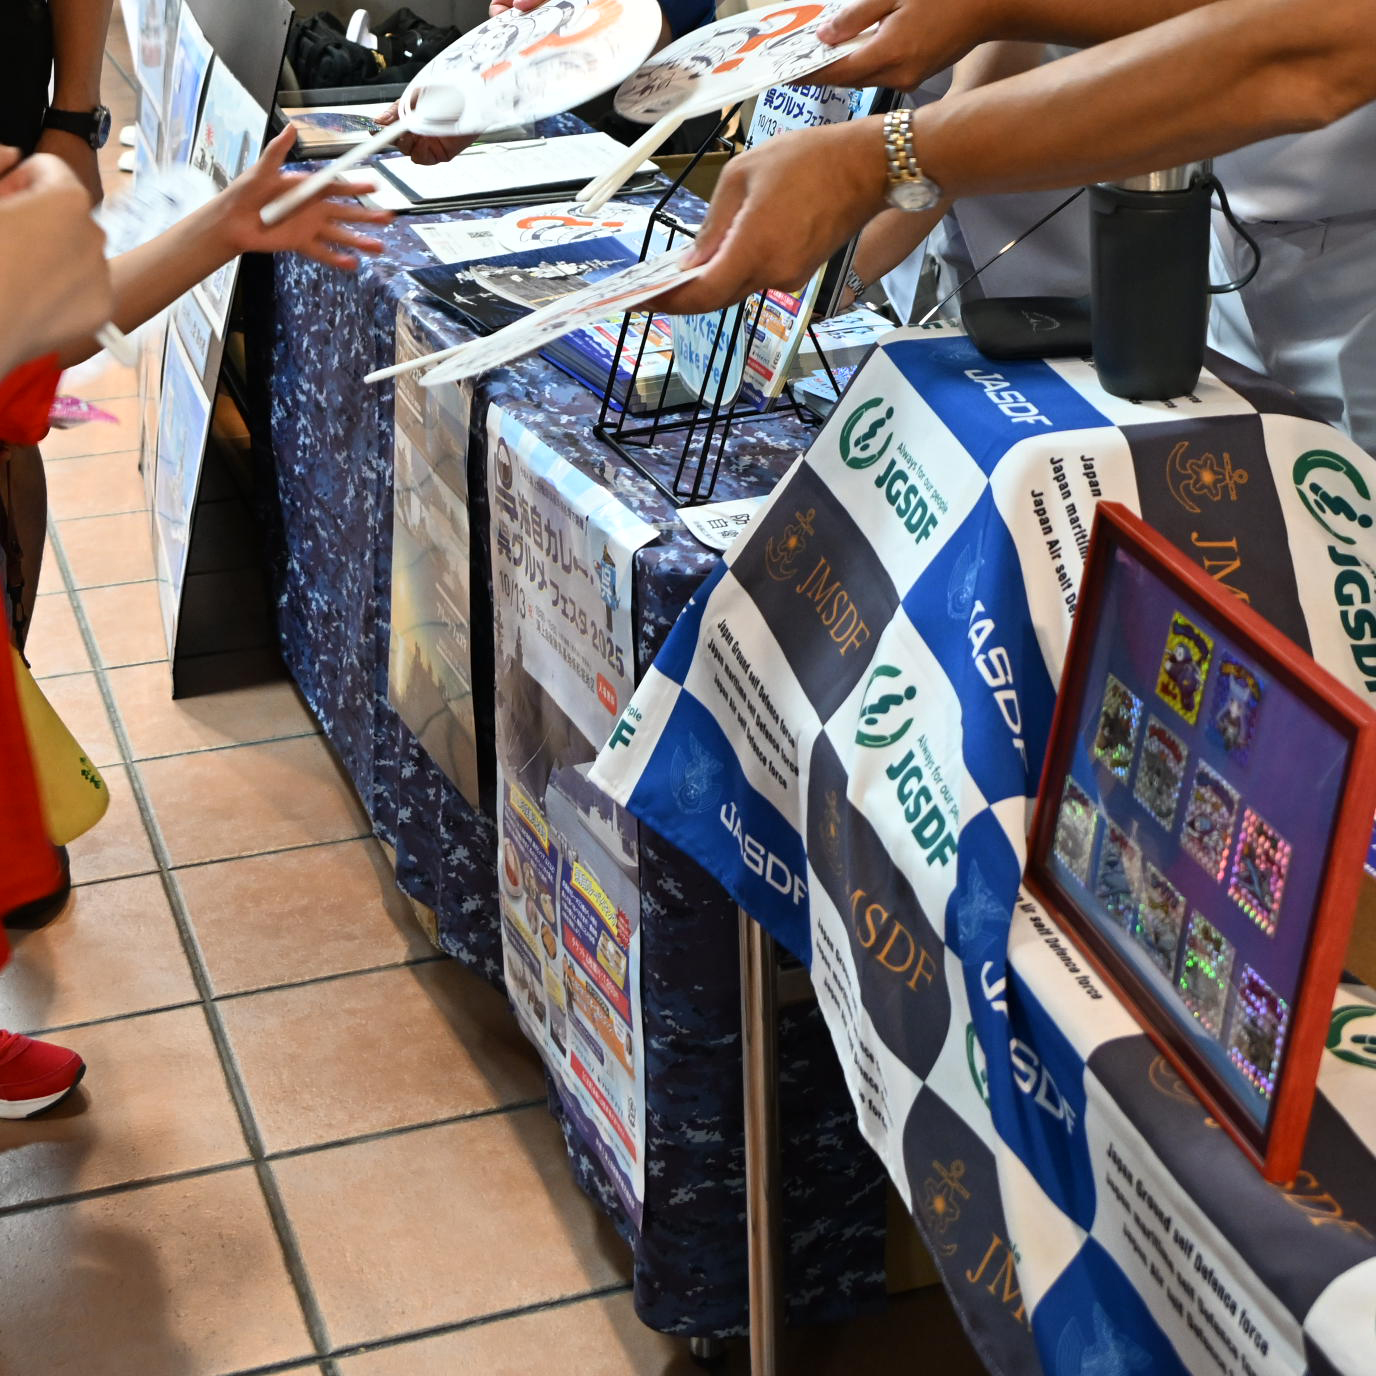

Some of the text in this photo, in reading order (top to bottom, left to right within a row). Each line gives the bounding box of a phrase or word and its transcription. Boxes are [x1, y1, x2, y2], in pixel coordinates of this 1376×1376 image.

[758, 113, 777, 137] 10/13
[963, 367, 1054, 426] JASDF
[874, 457, 940, 546] JGSDF
[897, 442, 949, 516] Always for our people
[1050, 457, 1072, 500] Japan
[1080, 455, 1102, 498] Japan
[1031, 489, 1054, 536] Japan
[1046, 538, 1062, 561] Air
[1055, 563, 1073, 593] self
[499, 570, 527, 620] 10/13
[795, 555, 871, 657] JMSDF
[590, 620, 625, 678] 2025
[717, 619, 796, 749] Japan Ground self Defence force
[707, 638, 725, 667] Japan
[724, 662, 747, 704] maritime
[755, 714, 780, 754] Defence
[781, 747, 799, 777] force
[713, 673, 729, 703] Japan
[768, 760, 788, 790] force
[886, 748, 958, 868] JGSDF
[917, 733, 935, 771] Always
[932, 766, 943, 785] for
[939, 784, 955, 806] our
[718, 798, 808, 906] JASDF
[848, 886, 937, 992] SDF
[1044, 936, 1080, 974] Defence
[1075, 974, 1103, 1000] force
[1106, 1142, 1135, 1187] Japan
[1135, 1178, 1172, 1233] Ground
[1173, 1227, 1195, 1261] self
[1193, 1253, 1239, 1317] Defence
[1238, 1308, 1270, 1358] force
